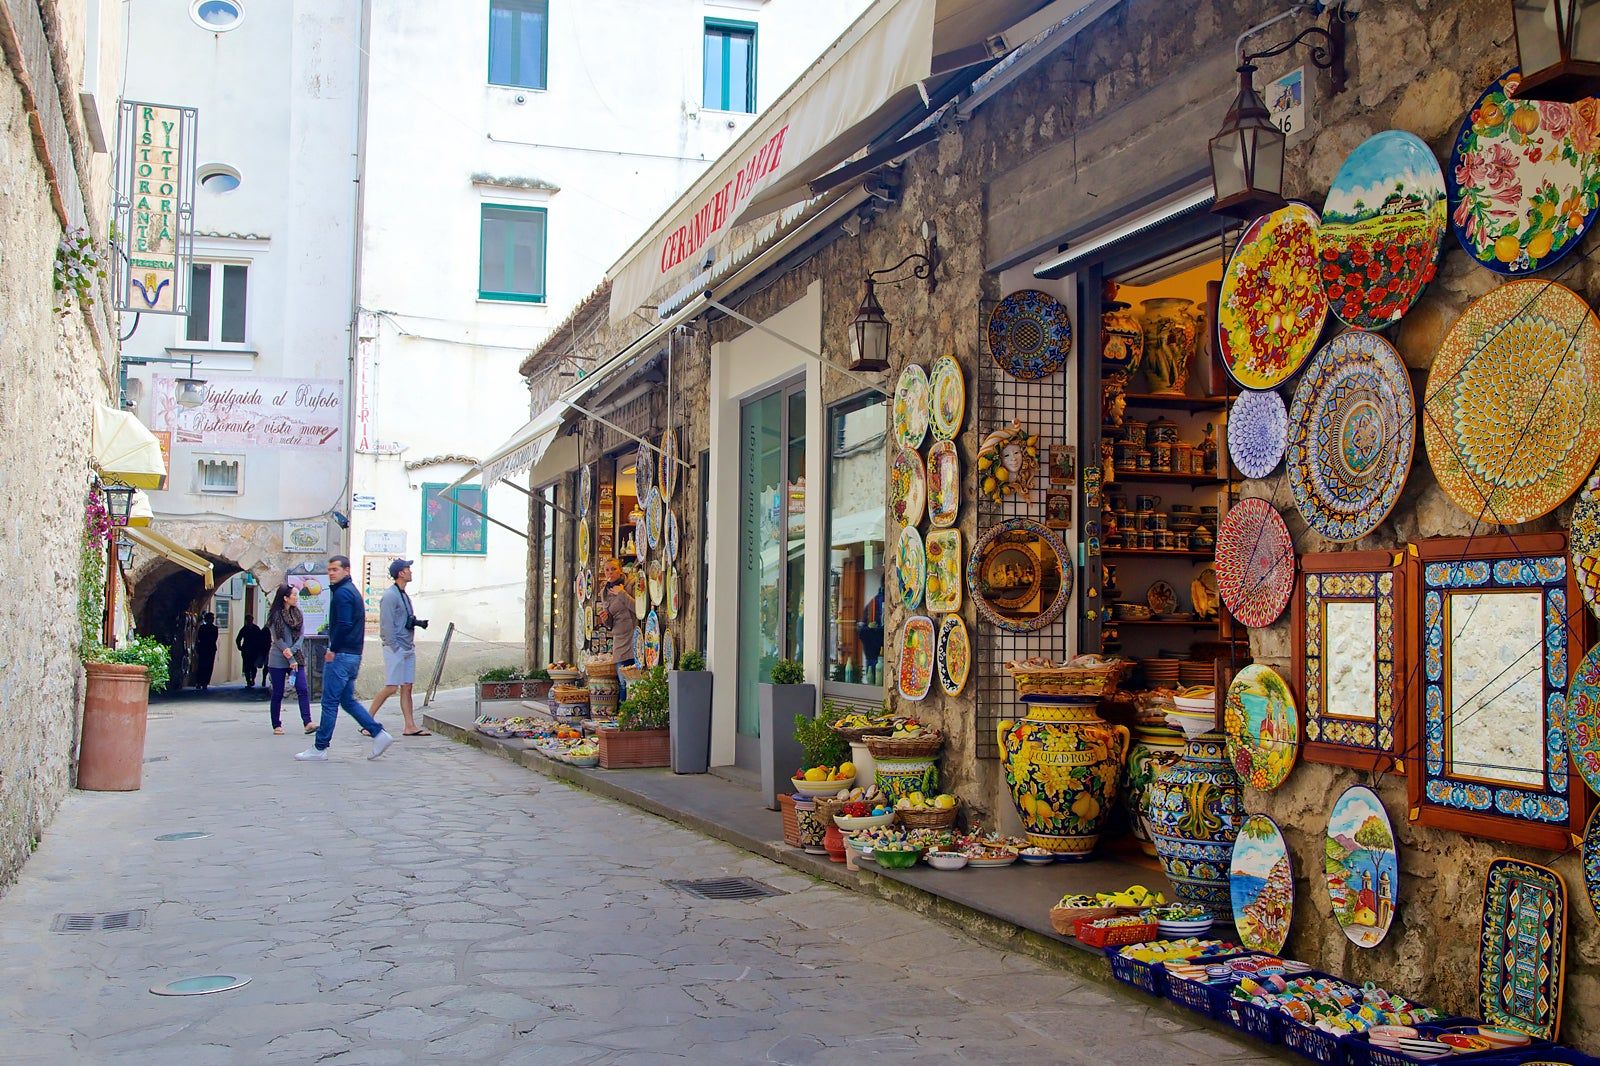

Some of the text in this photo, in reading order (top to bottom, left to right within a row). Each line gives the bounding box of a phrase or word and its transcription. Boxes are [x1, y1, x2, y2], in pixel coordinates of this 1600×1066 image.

[1278, 114, 1292, 132] 16
[137, 107, 154, 252] RISTORANTE
[159, 120, 175, 240] VITTORIA
[272, 390, 288, 405] al
[295, 383, 340, 413] Rufolo
[192, 411, 330, 435] Ristorante vista mare
[748, 489, 756, 525] hair
[748, 529, 756, 571] total
